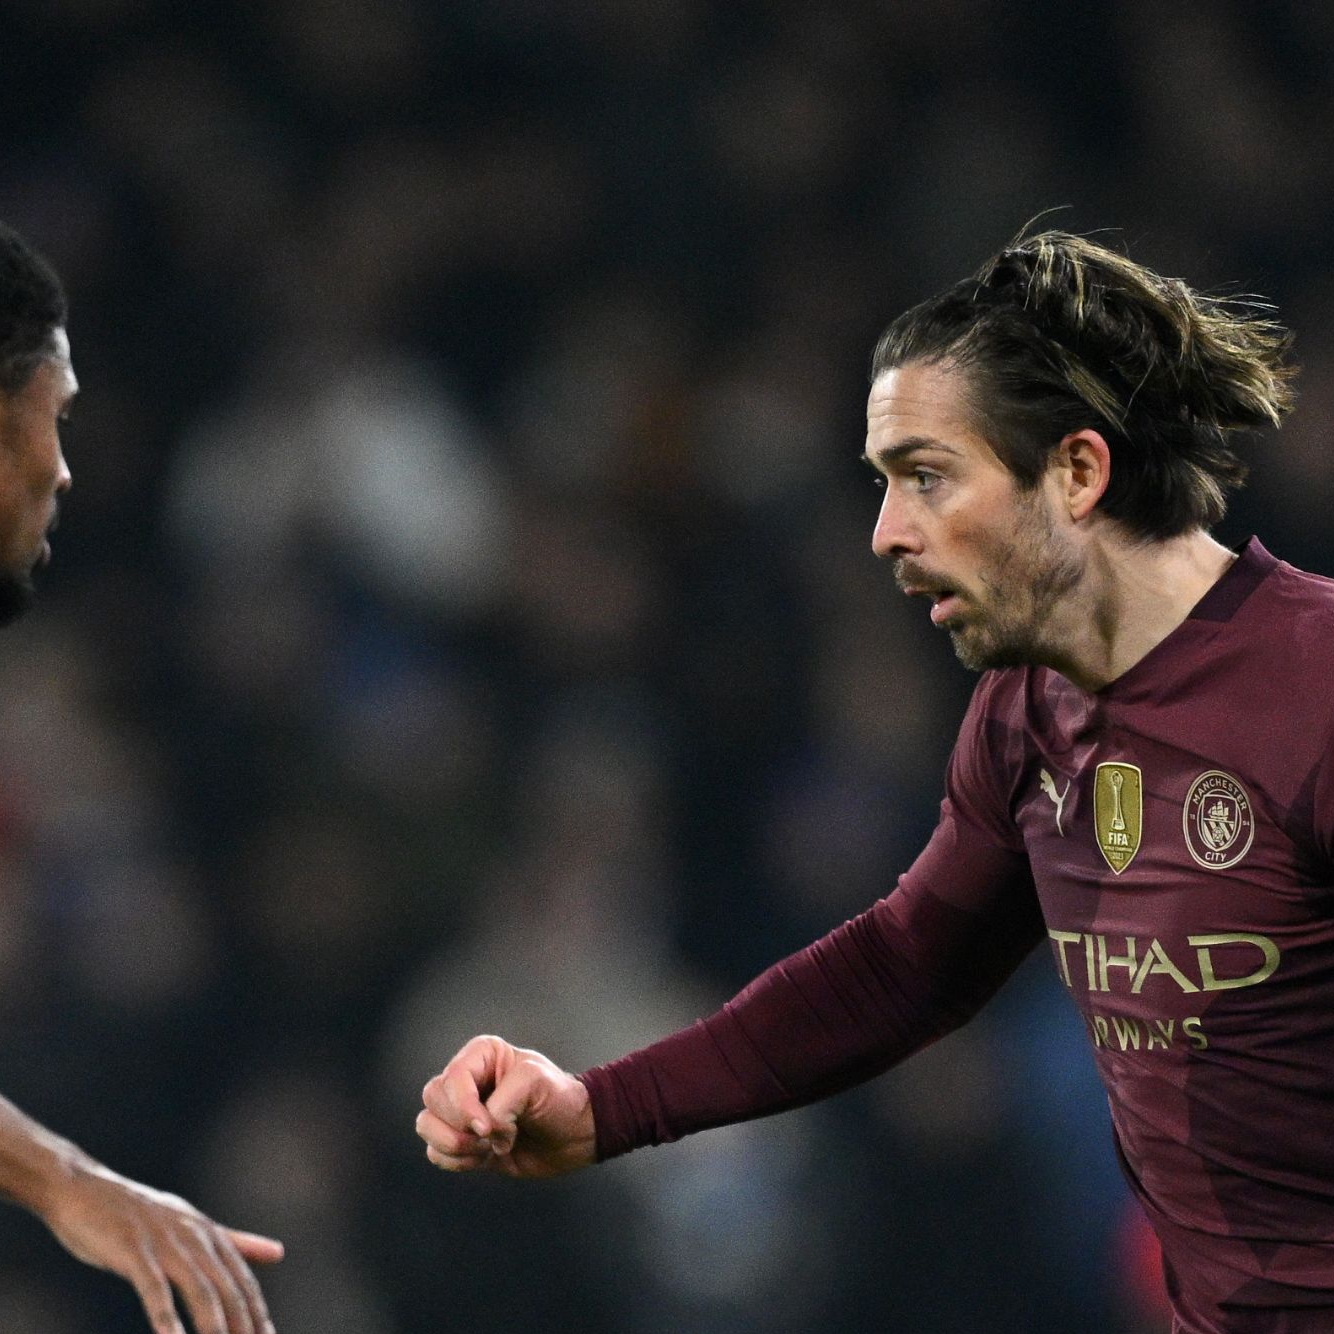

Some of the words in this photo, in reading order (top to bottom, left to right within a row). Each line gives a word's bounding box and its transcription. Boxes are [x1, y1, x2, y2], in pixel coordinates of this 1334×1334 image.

[1192, 777, 1247, 811] MANCHESTER
[1108, 832, 1129, 847] FIFA
[1204, 851, 1227, 863] CITY
[1049, 928, 1281, 993] TIHAD
[1092, 1014, 1209, 1050] RWAYS
